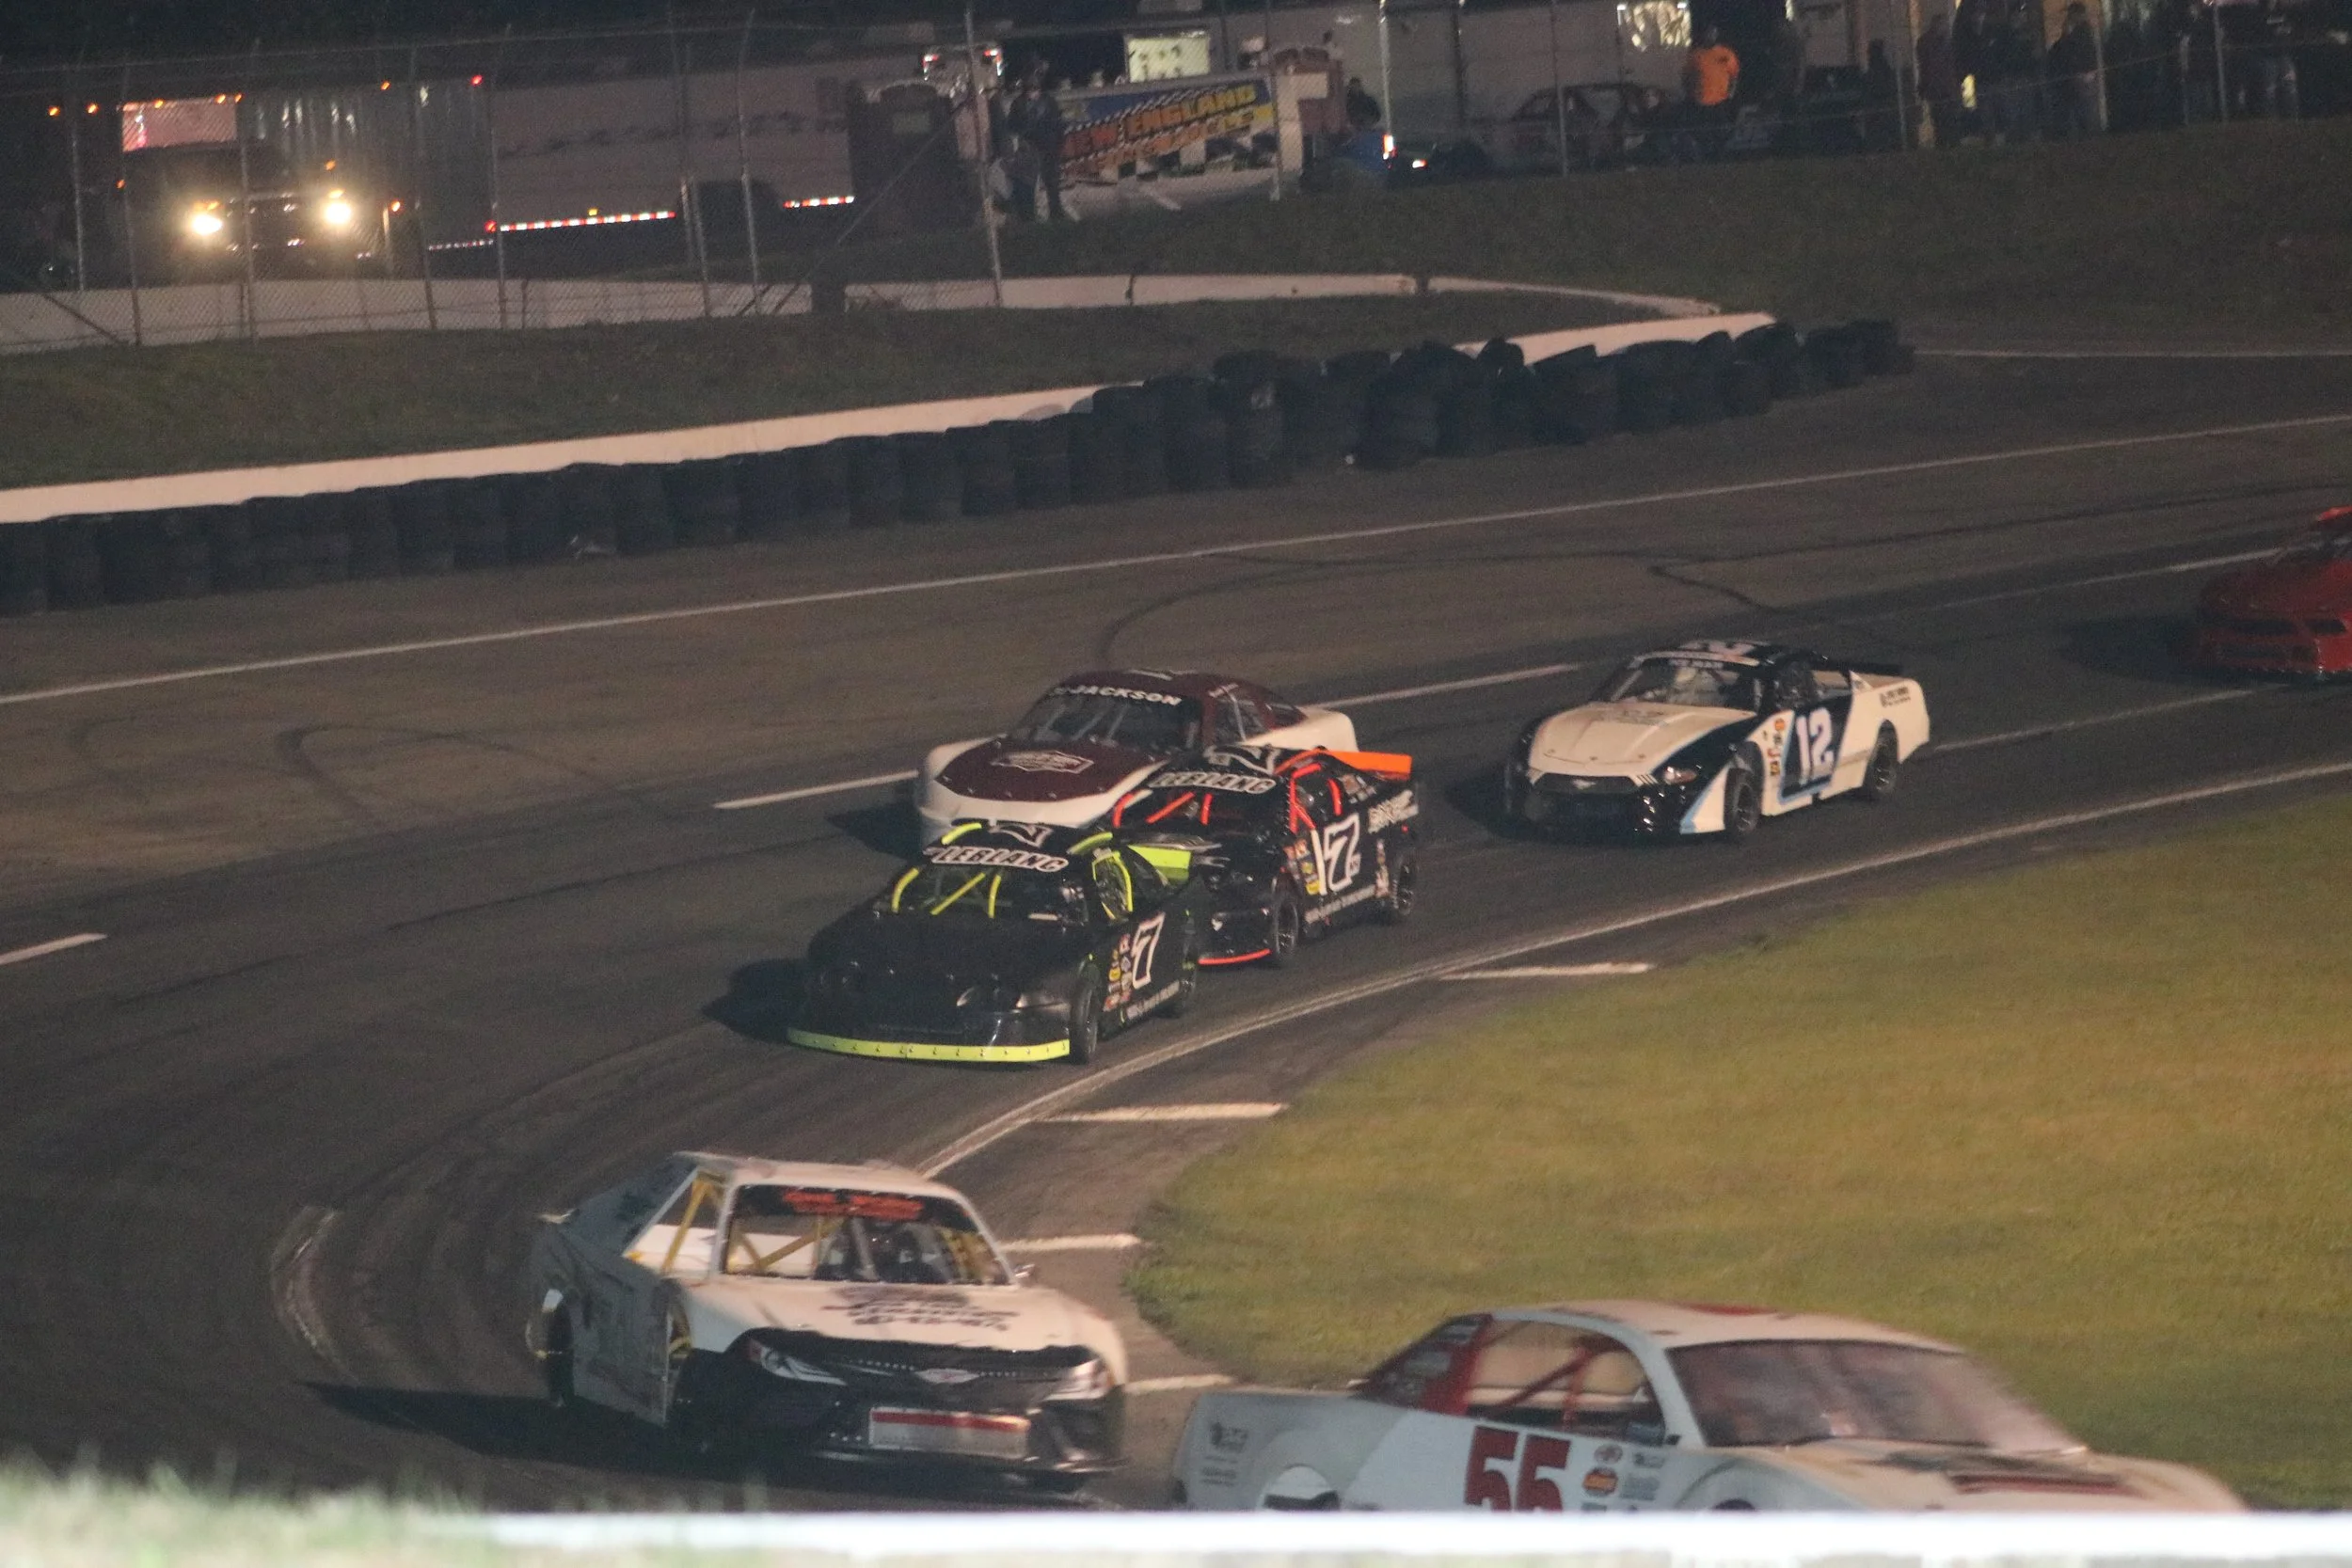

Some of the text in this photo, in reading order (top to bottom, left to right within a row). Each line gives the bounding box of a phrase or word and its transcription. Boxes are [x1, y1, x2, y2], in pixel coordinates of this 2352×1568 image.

[1796, 707, 1835, 785] 12
[1131, 911, 1166, 990] 7
[1464, 1425, 1571, 1513] 55
